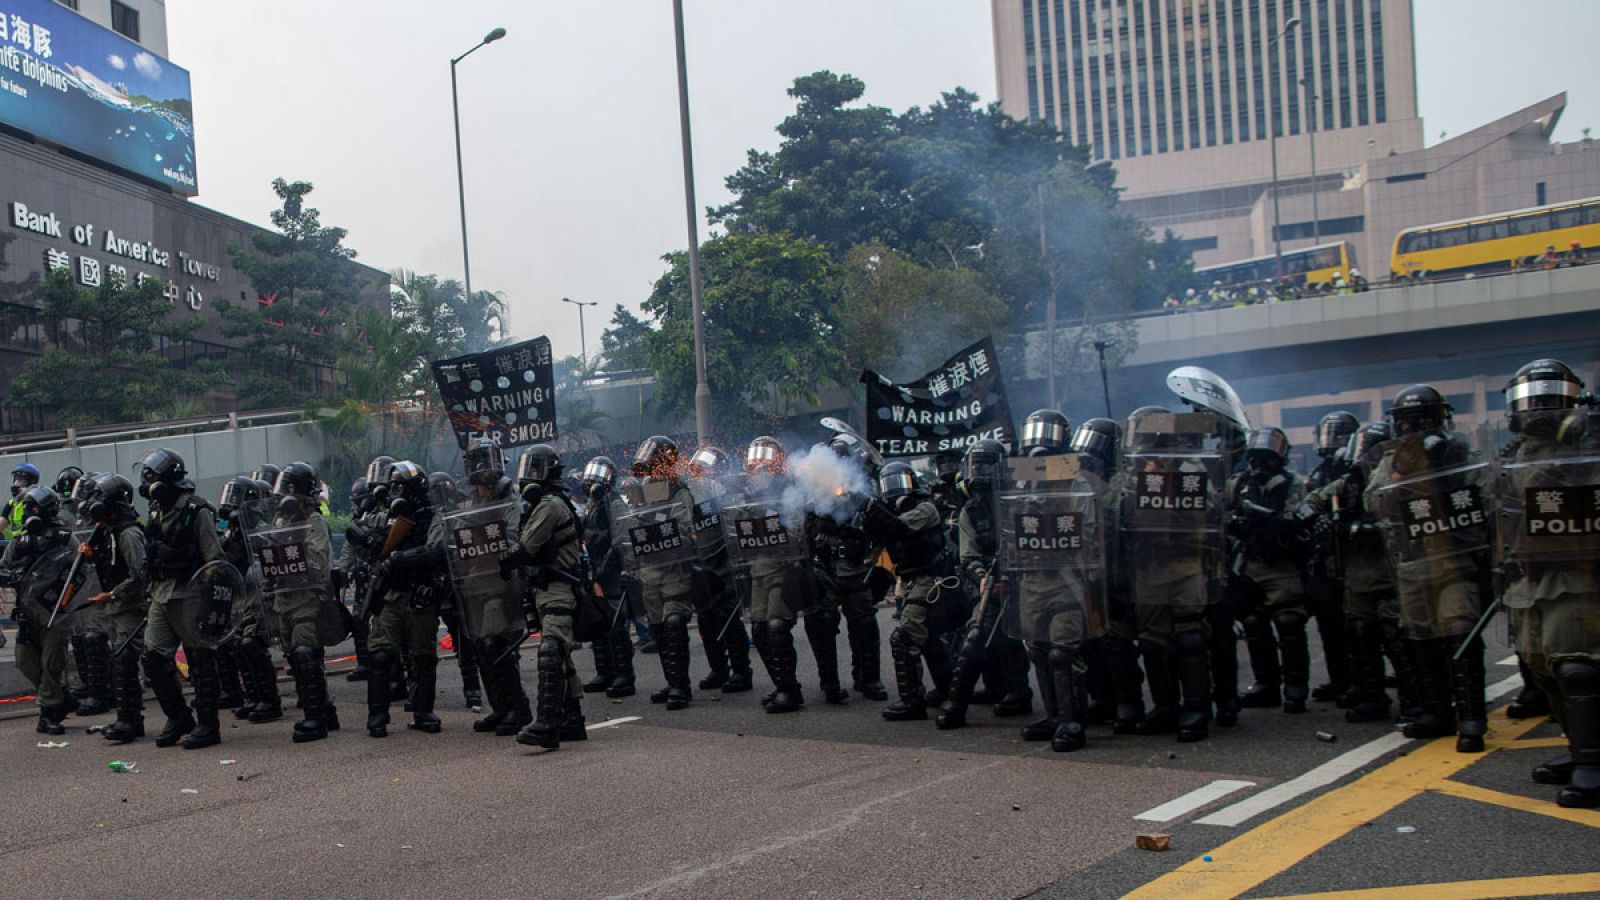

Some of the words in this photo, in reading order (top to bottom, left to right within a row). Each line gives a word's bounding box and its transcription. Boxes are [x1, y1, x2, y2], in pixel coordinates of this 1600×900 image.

[23, 53, 68, 93] dolphins
[13, 201, 62, 238] Bank
[74, 223, 94, 246] of
[106, 230, 170, 268] America
[179, 250, 221, 282] Tower
[928, 349, 990, 399] 催淚煙
[465, 387, 543, 413] WARNING
[892, 400, 982, 424] WARNING
[876, 439, 929, 454] TEAR
[938, 427, 1005, 451] SMOKE
[1144, 475, 1200, 493] 警察
[1139, 496, 1204, 509] POLICE
[1408, 490, 1473, 519] 警察
[1409, 510, 1485, 538] POLICE
[460, 541, 507, 559] POLICE
[635, 536, 682, 554] POLICE
[739, 532, 788, 548] POLICE
[1018, 535, 1081, 549] POLICE
[263, 562, 306, 577] POLICE
